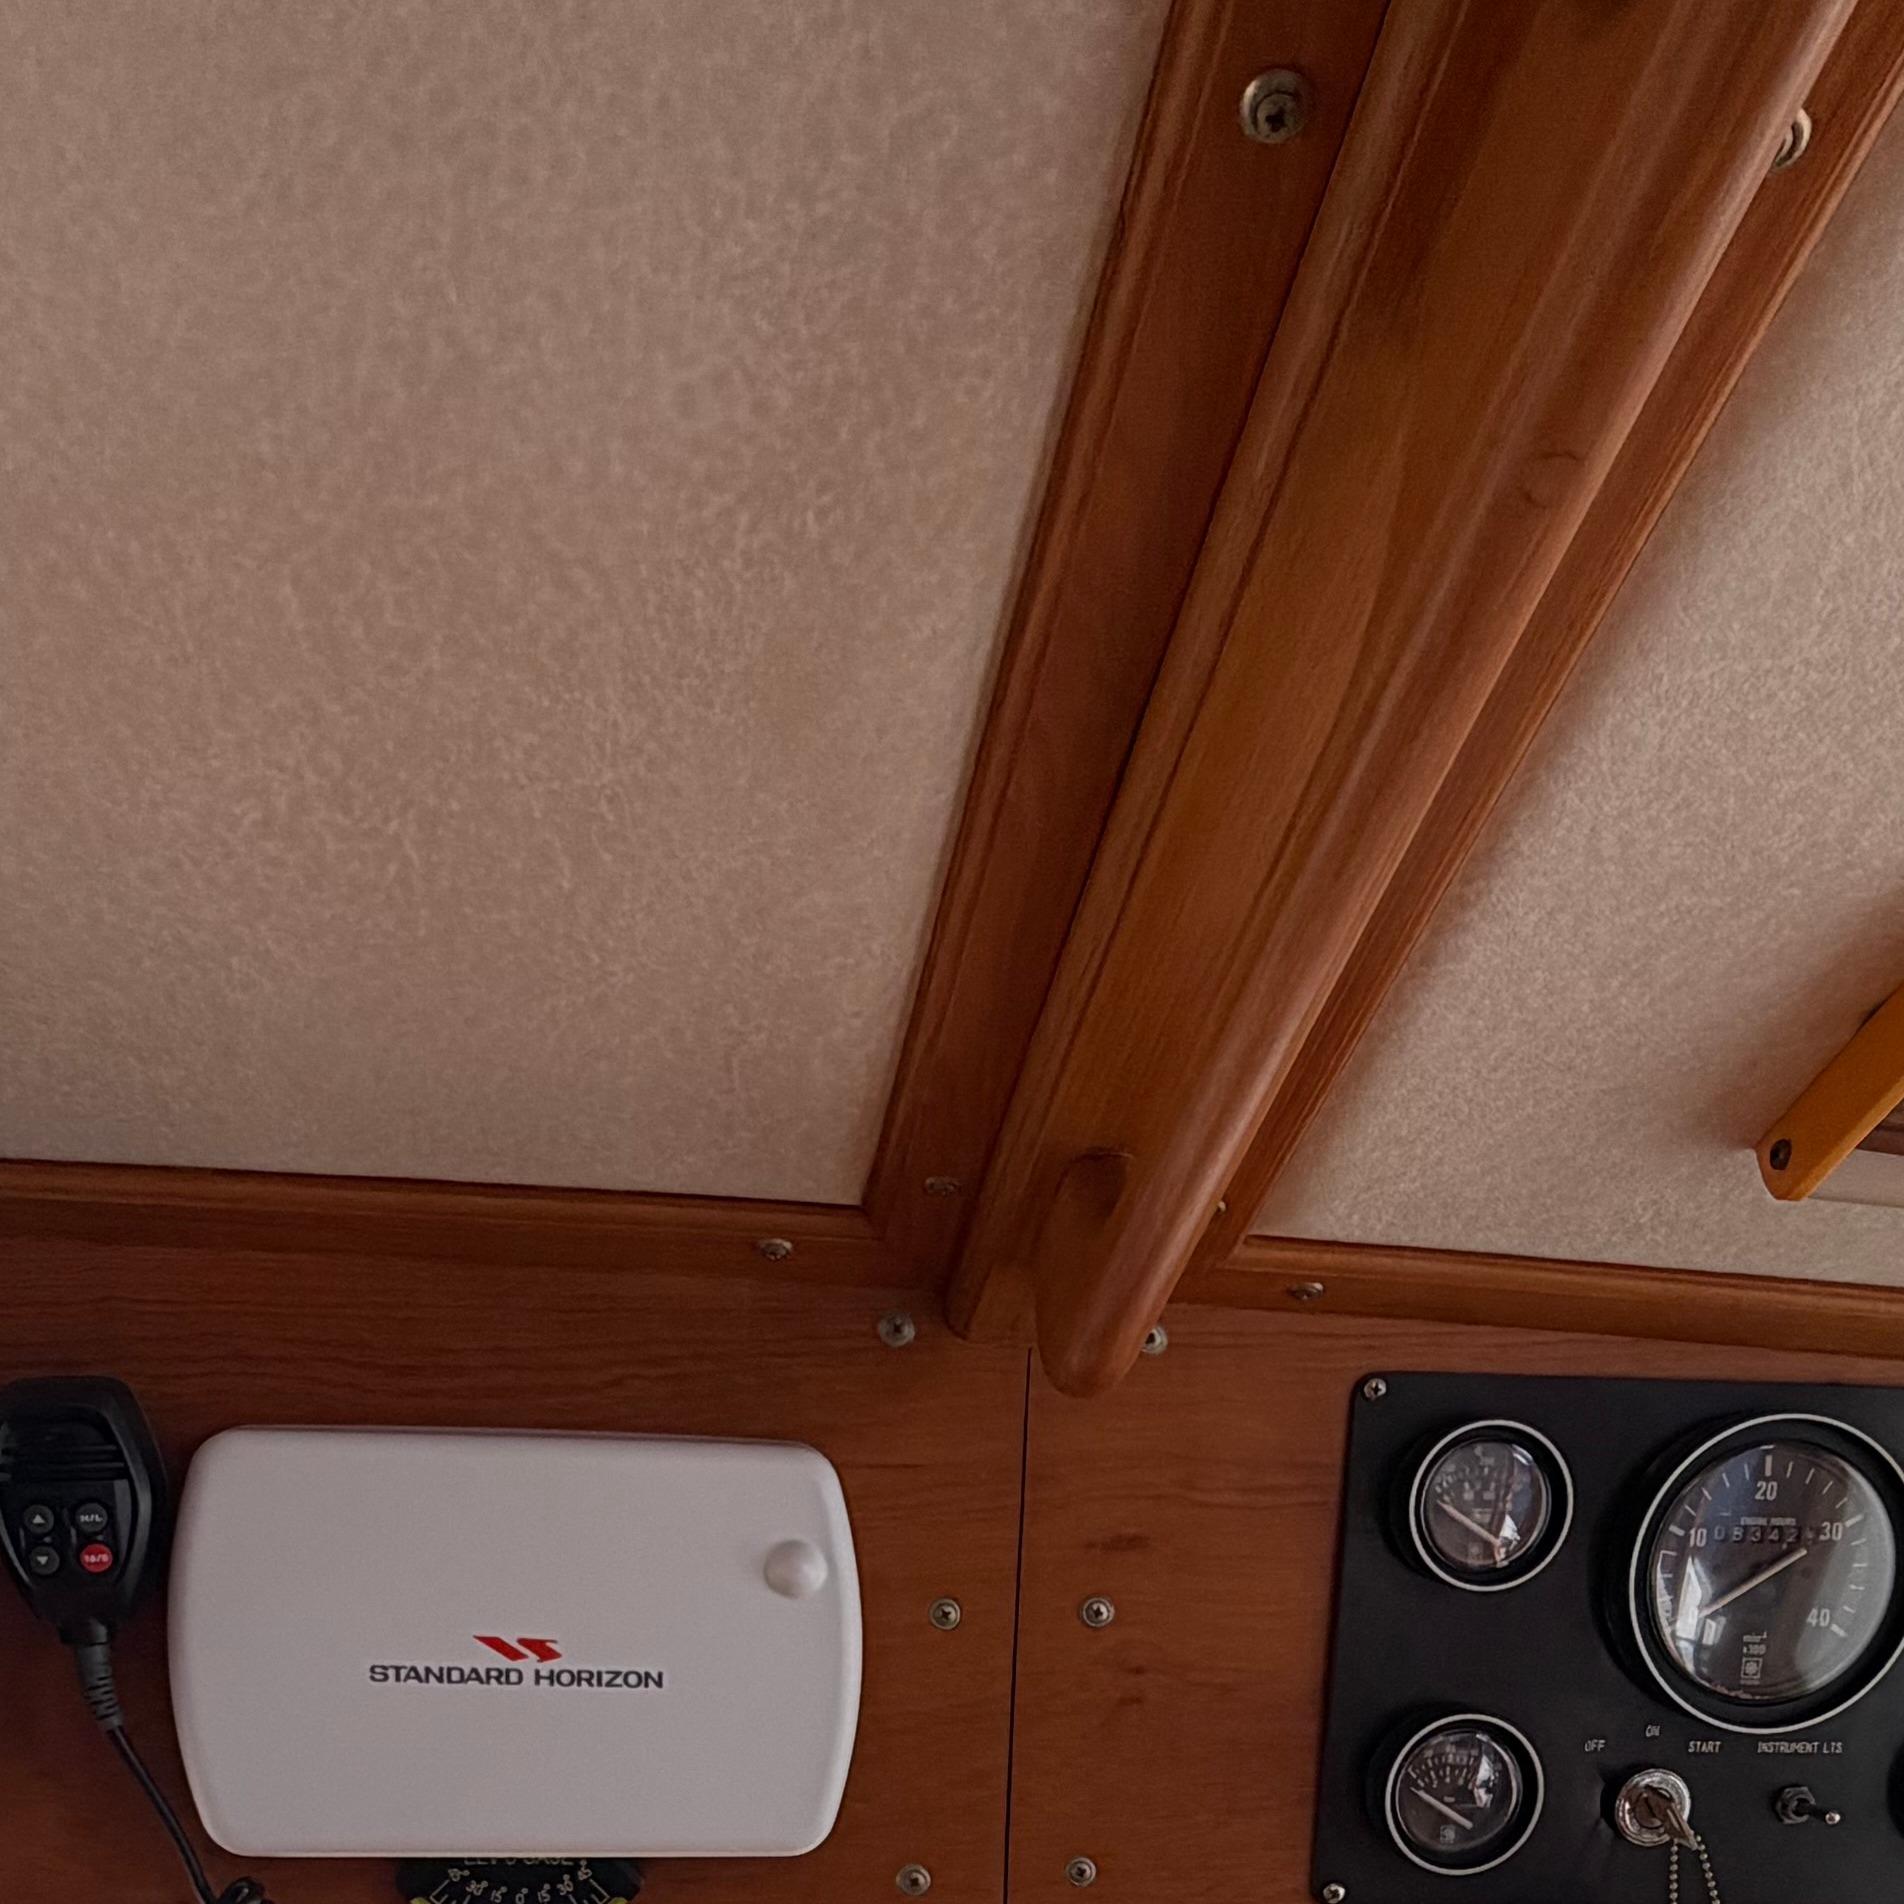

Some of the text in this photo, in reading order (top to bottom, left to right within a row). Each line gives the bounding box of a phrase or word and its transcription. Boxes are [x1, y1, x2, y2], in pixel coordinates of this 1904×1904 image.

[1755, 1481, 1777, 1500] 20
[1689, 1527, 1707, 1547] 10
[1819, 1521, 1844, 1541] 30
[1806, 1608, 1830, 1627] 40
[369, 1664, 664, 1688] STANDARD HORIZON
[1645, 1724, 1661, 1737] ON
[1585, 1739, 1606, 1752] OFF
[1688, 1741, 1722, 1752] START
[1757, 1741, 1819, 1753] INSTRUMENT
